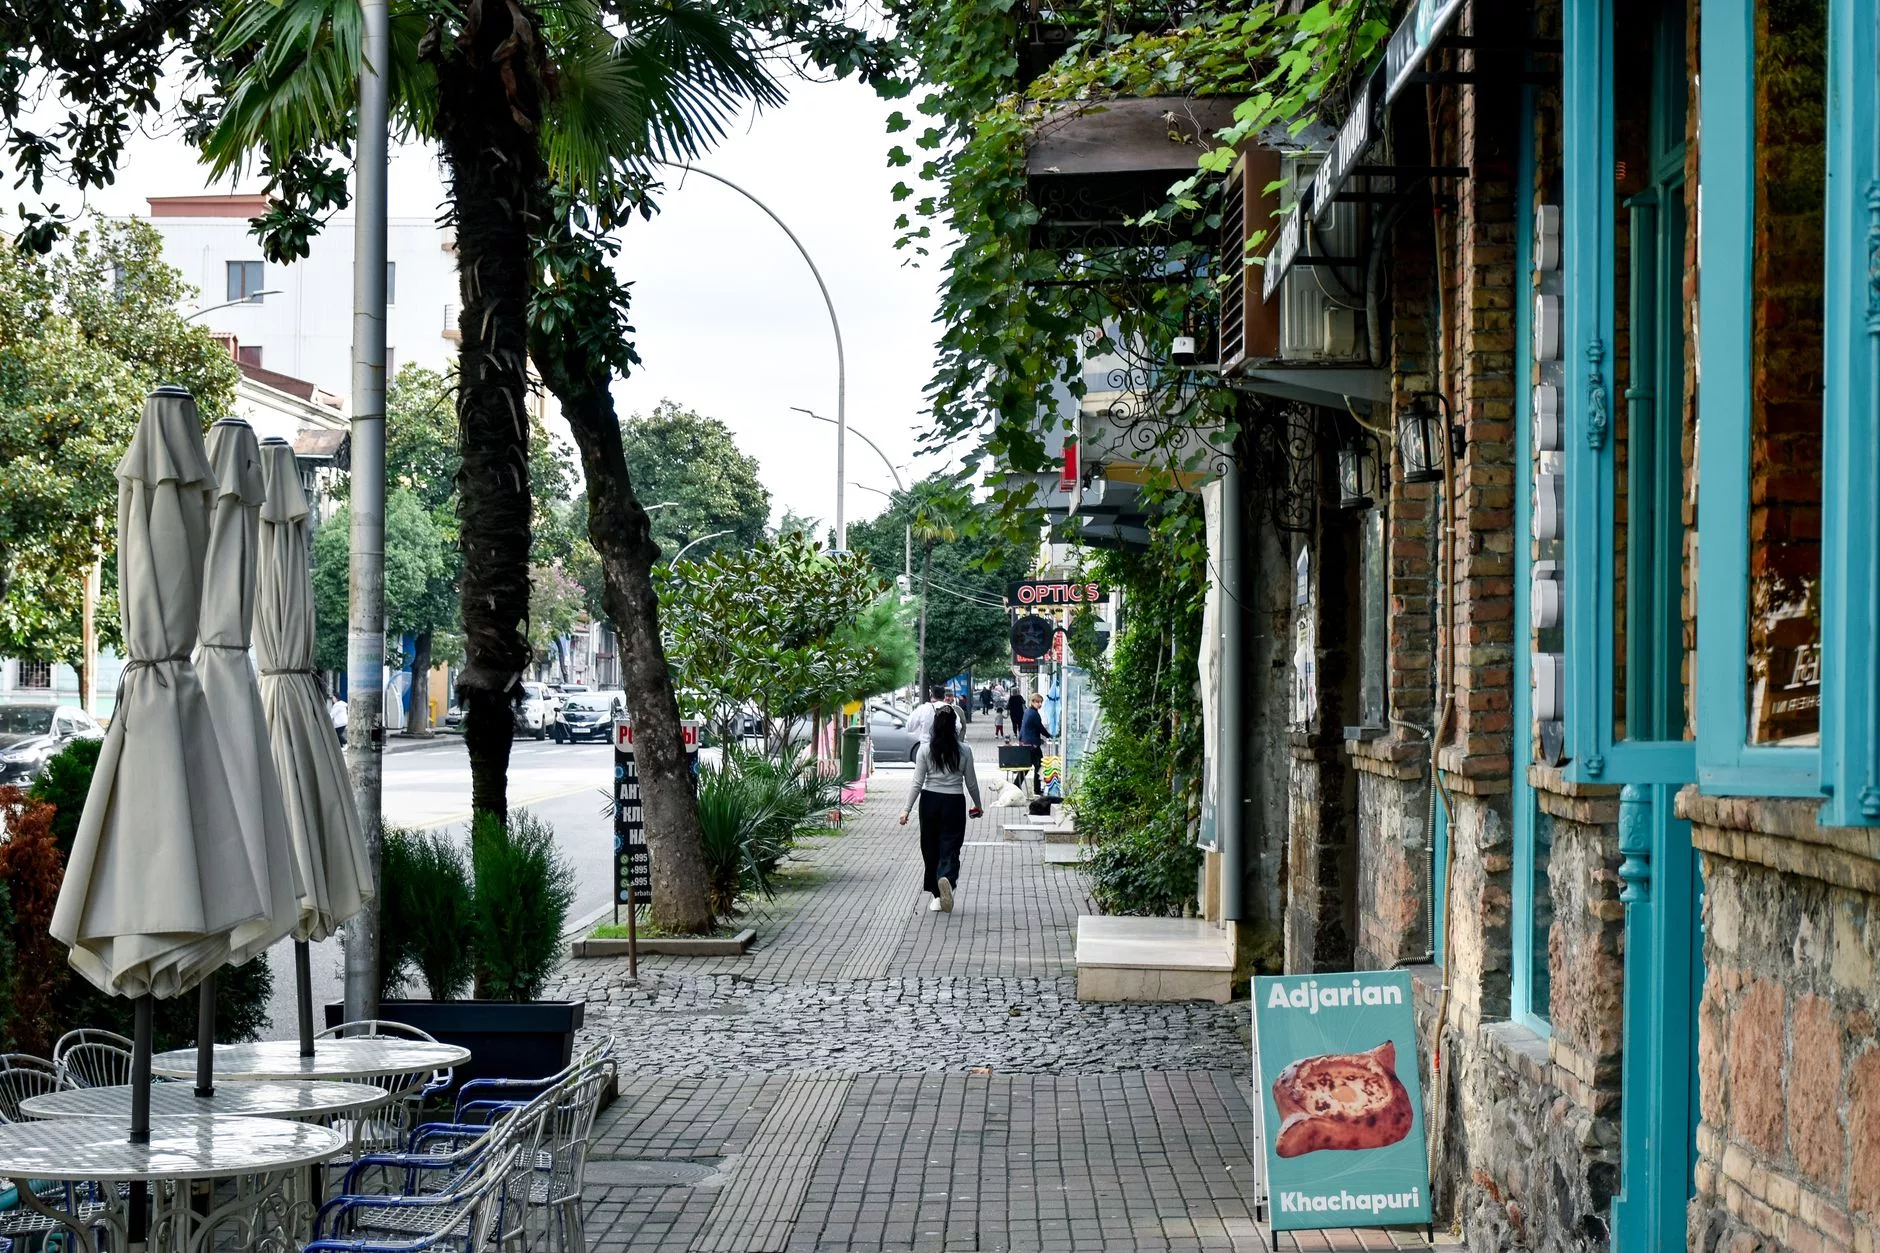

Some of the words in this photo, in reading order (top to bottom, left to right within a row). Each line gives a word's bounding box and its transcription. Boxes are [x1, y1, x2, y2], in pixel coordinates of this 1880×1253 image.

[1017, 583, 1099, 603] OPTICS
[1267, 979, 1402, 1014] Adjarian
[1280, 1187, 1420, 1215] Khachapuri
